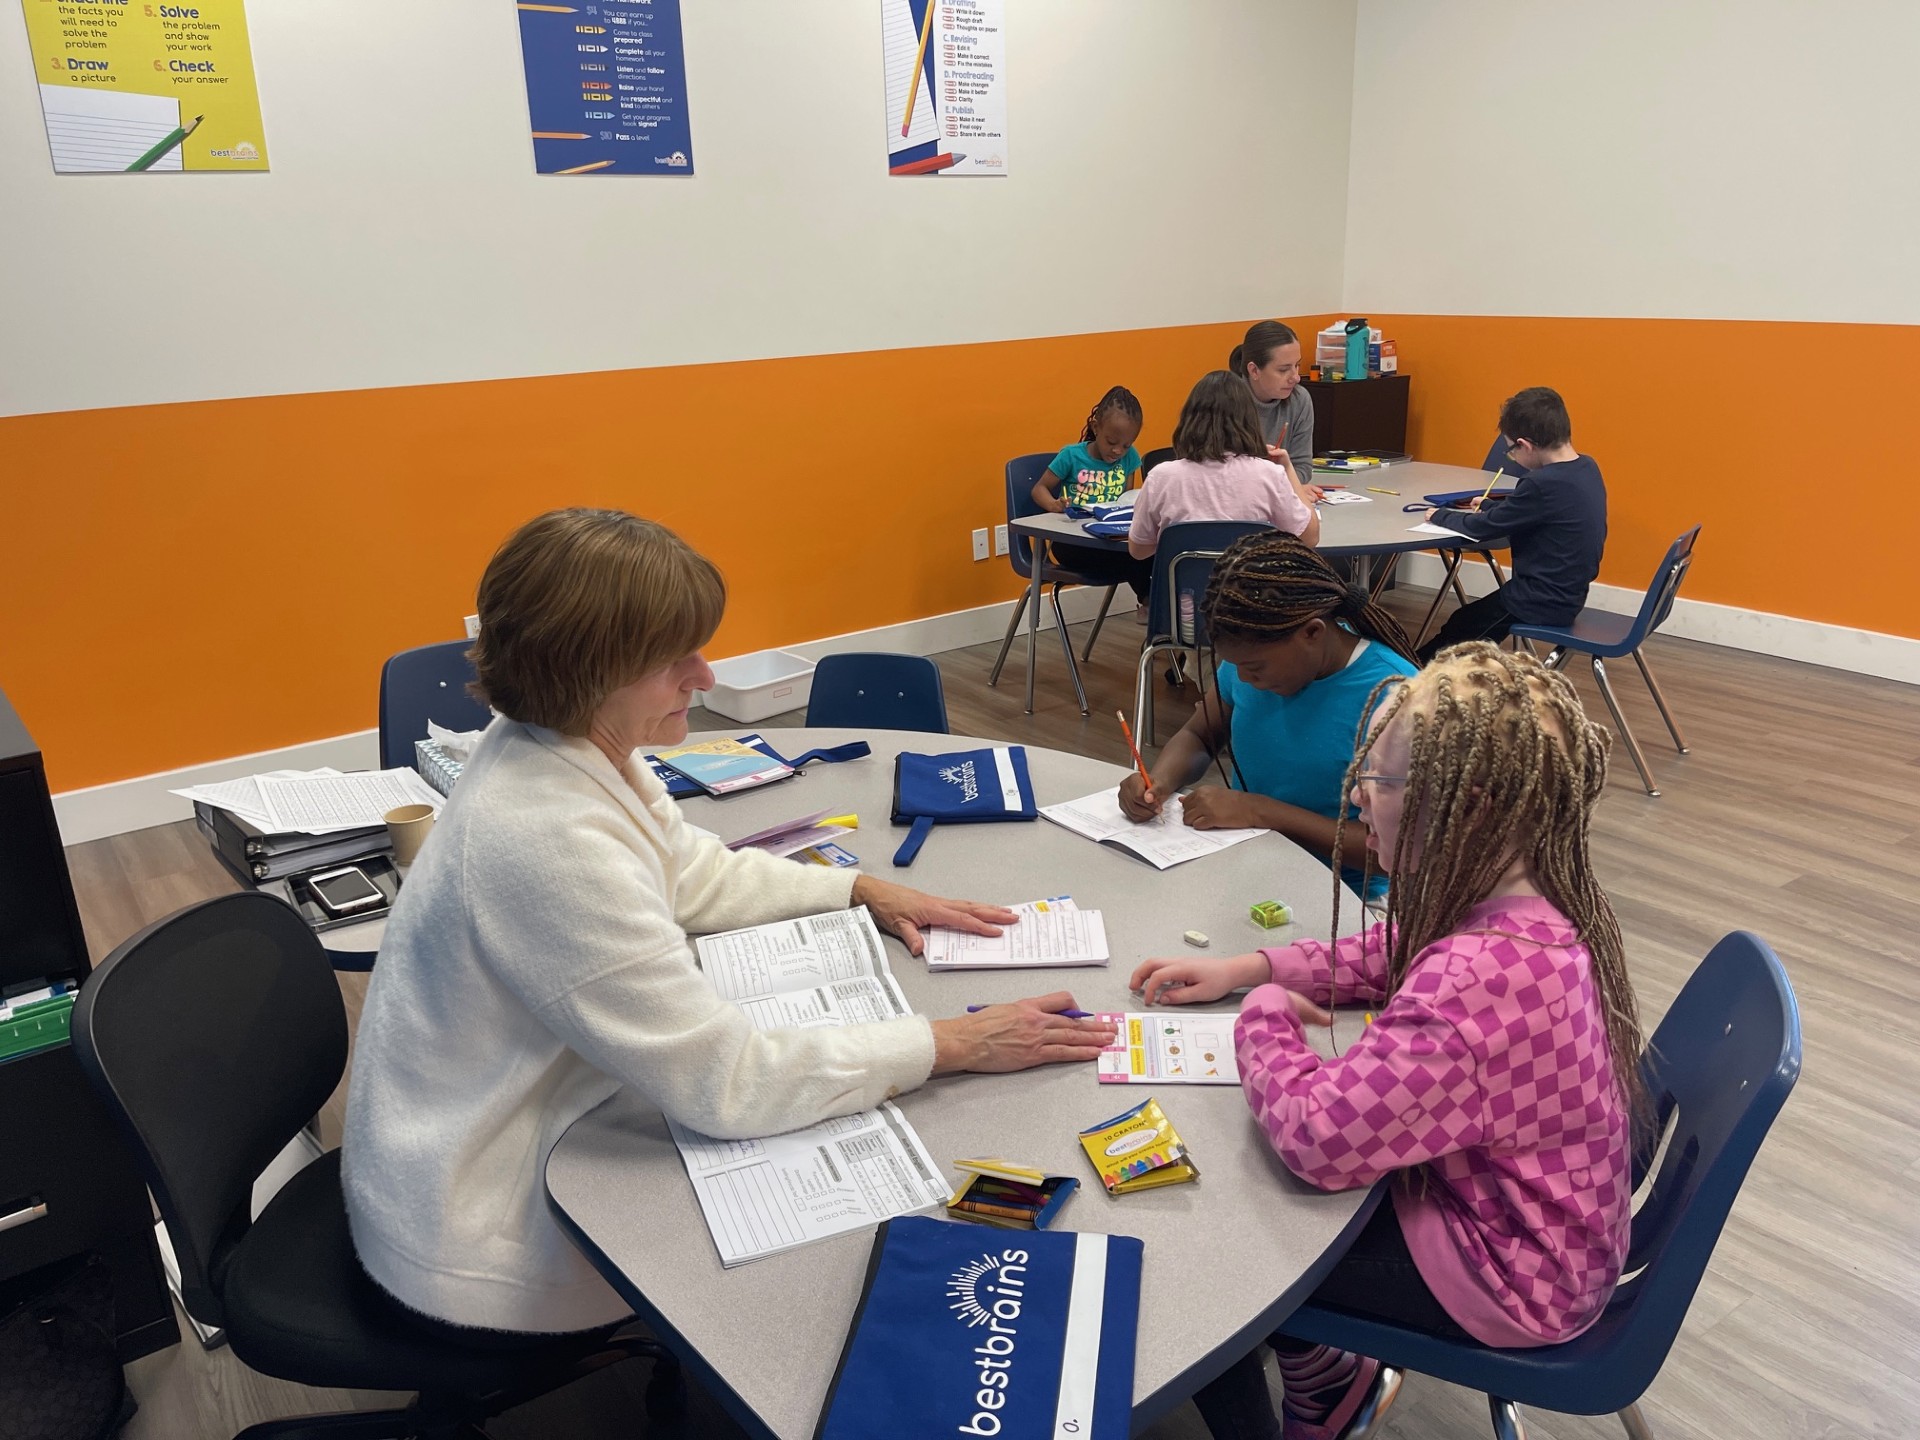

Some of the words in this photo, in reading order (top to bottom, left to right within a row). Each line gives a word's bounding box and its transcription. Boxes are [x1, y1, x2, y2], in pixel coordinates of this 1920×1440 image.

[58, 6, 75, 14] the
[78, 6, 103, 16] facts
[105, 9, 124, 18] you
[144, 5, 157, 17] 5.
[160, 5, 199, 18] Solve
[182, 22, 220, 31] problem
[63, 29, 88, 37] solve
[65, 40, 107, 49] problem
[943, 34, 950, 42] C.
[951, 35, 977, 45] Revising
[51, 58, 65, 70] 3.
[67, 58, 109, 71] Draw
[153, 60, 166, 71] 6.
[169, 60, 215, 72] Check
[81, 74, 116, 84] picture
[172, 76, 193, 84] your
[952, 71, 994, 82] Proofreading
[952, 106, 974, 114] Publish
[1078, 469, 1126, 486] GIRLS
[1108, 486, 1123, 495] DO
[1109, 1133, 1153, 1154] bestbrains
[958, 1249, 1029, 1436] bestbrains
